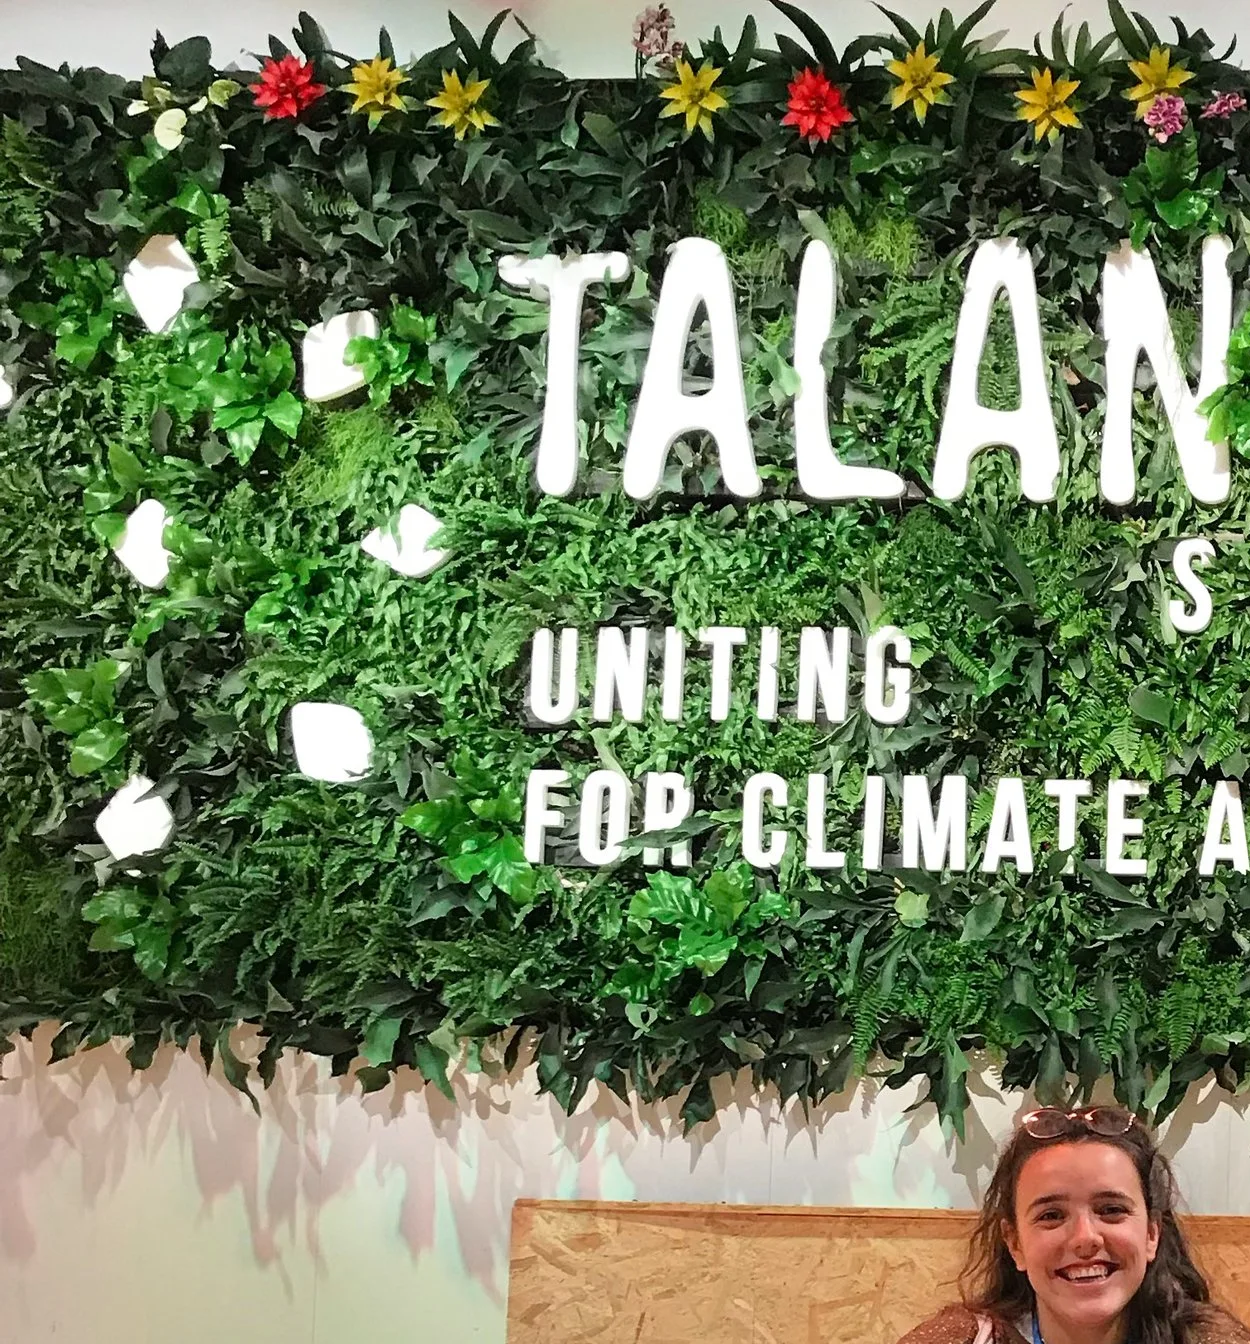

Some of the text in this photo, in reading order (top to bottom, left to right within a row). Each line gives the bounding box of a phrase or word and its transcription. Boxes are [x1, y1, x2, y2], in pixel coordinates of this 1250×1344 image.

[529, 625, 913, 726] UNITING
[524, 769, 696, 869] FOR
[740, 771, 1151, 877] CLIMATE
